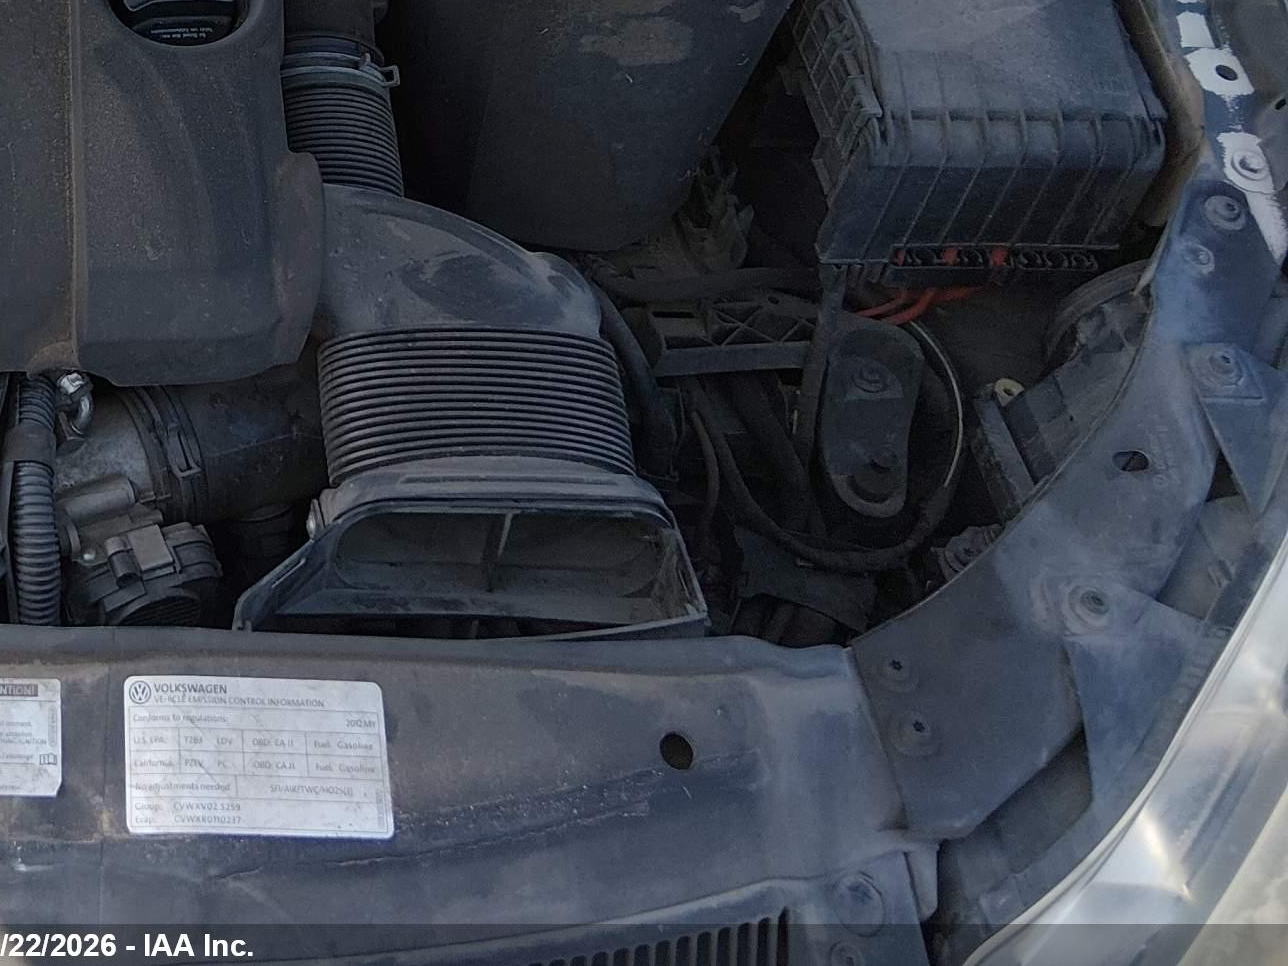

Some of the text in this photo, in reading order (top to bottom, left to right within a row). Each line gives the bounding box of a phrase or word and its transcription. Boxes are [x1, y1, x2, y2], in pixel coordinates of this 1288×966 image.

[154, 682, 228, 695] VOLKSWAGEN
[154, 695, 325, 708] VEHICLE EMISSION CONTROL INFORMATION
[172, 714, 181, 722] to
